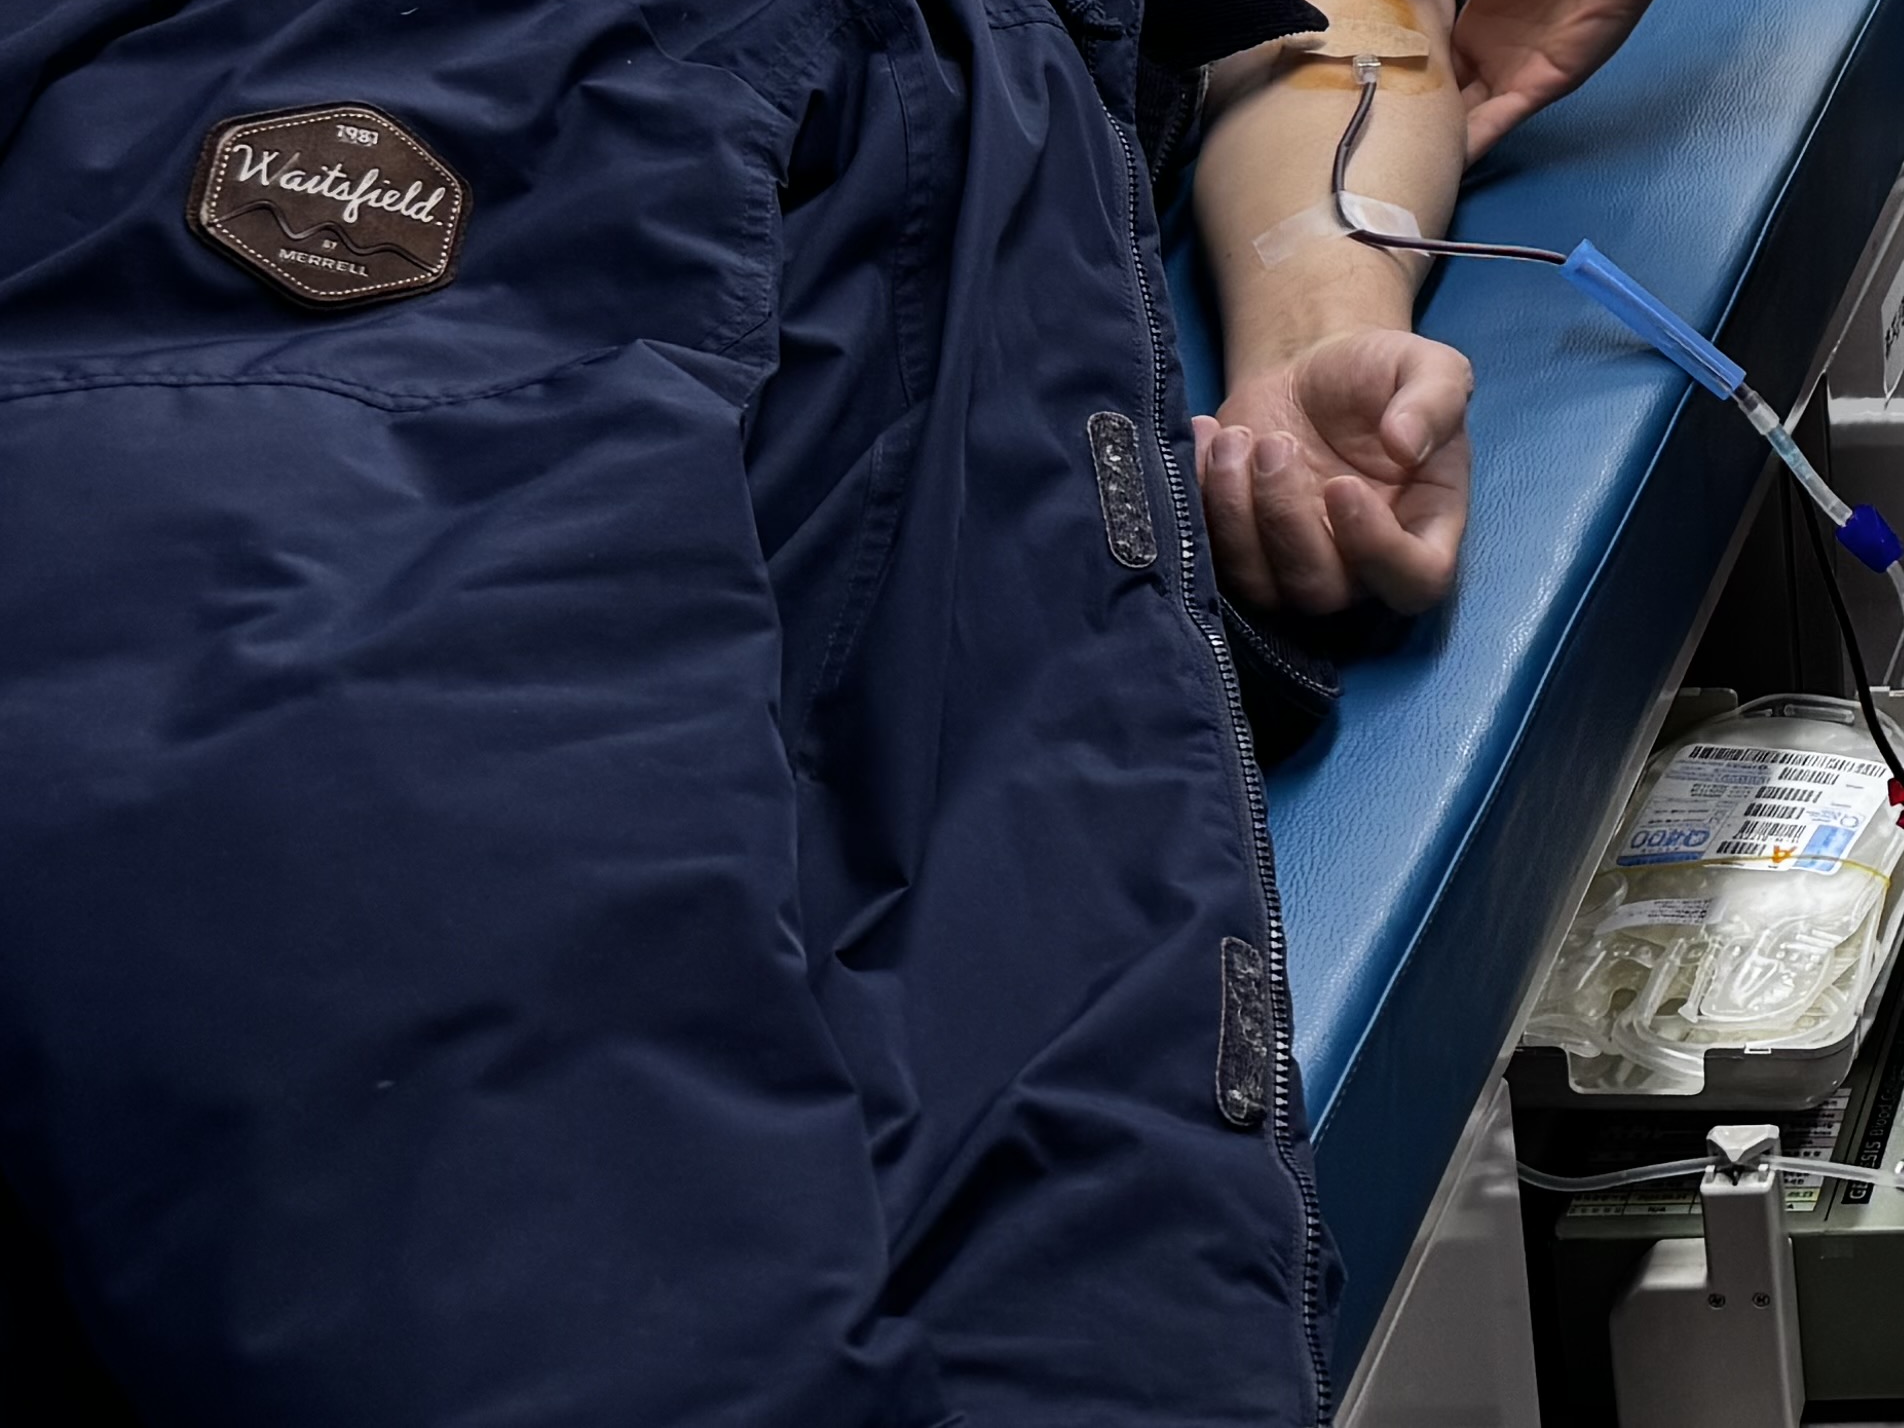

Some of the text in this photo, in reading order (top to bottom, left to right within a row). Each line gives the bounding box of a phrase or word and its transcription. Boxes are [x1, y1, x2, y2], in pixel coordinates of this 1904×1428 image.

[233, 144, 446, 224] Waitsfield
[279, 248, 369, 277] MERRELL
[1849, 1141, 1882, 1201] GESIS
